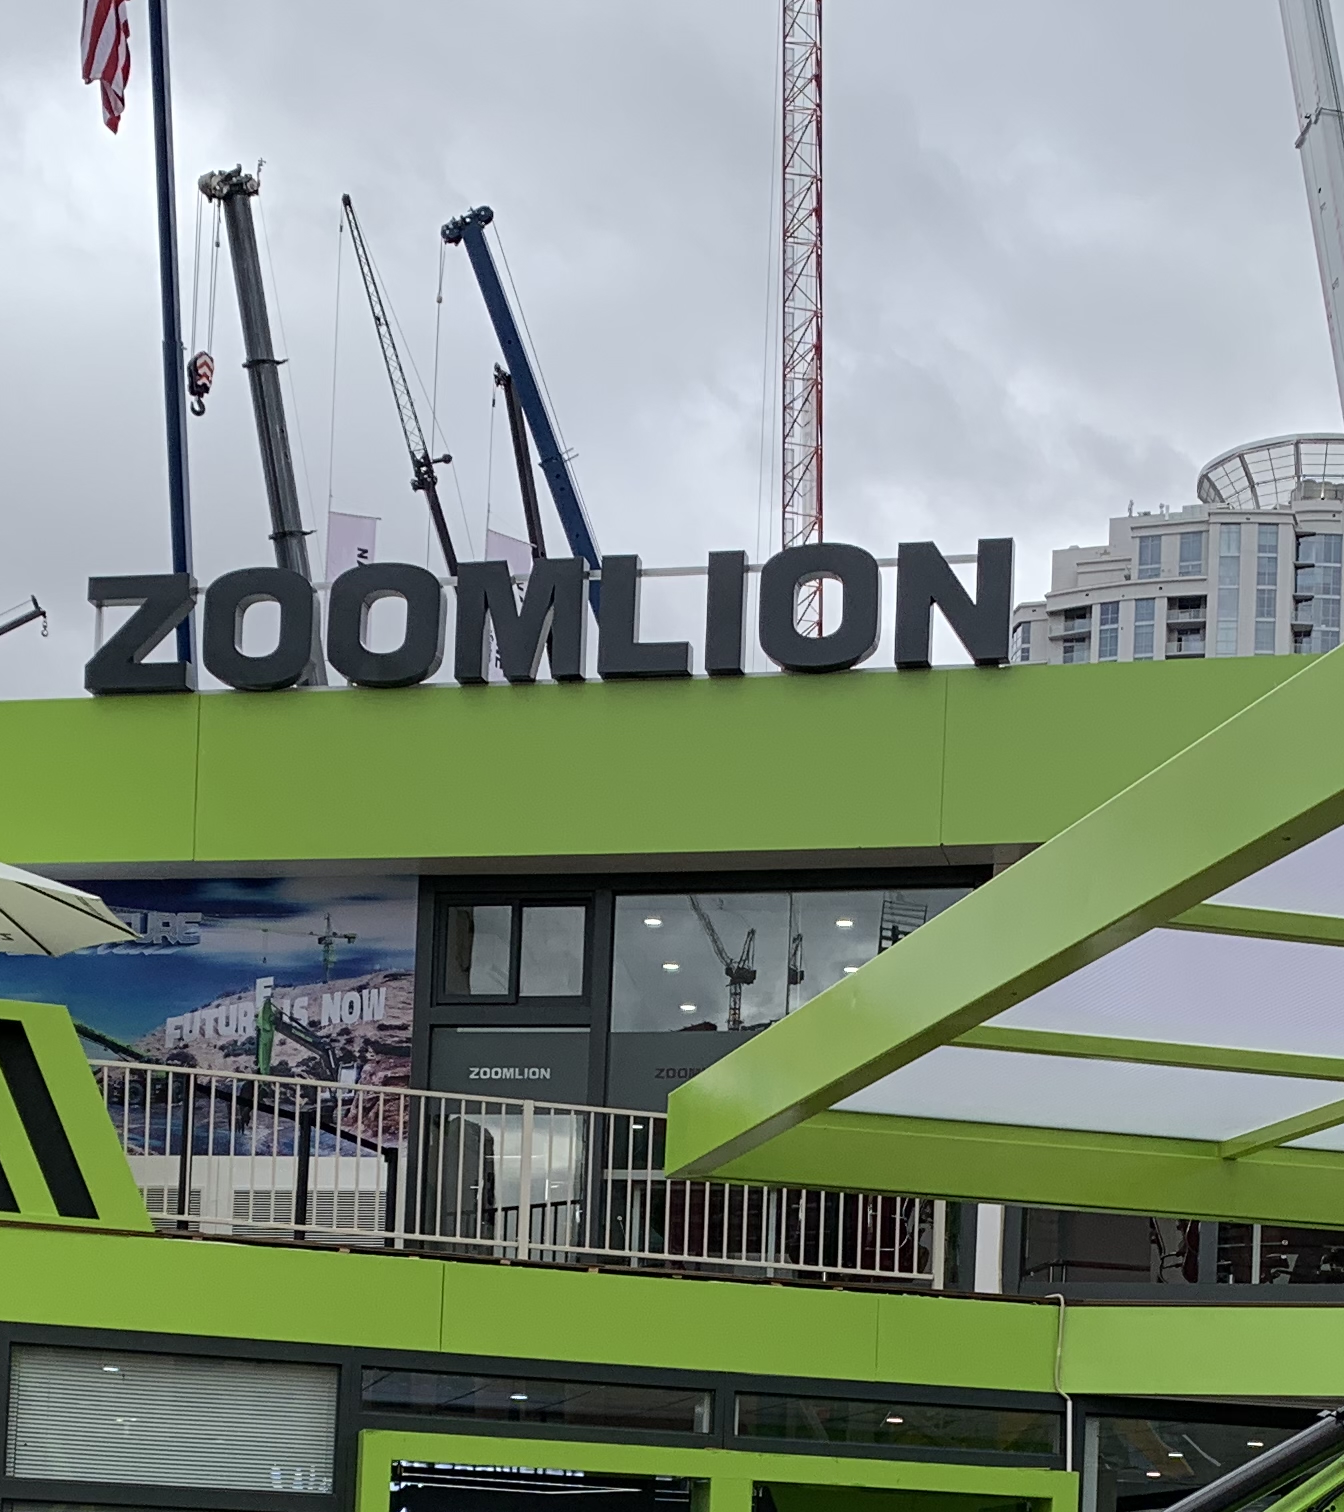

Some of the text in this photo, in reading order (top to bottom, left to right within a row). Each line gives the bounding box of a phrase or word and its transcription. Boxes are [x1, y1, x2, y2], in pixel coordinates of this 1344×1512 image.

[84, 537, 1014, 694] ZOOMLION
[321, 987, 387, 1026] NOW
[469, 1066, 551, 1080] ZOOMLION
